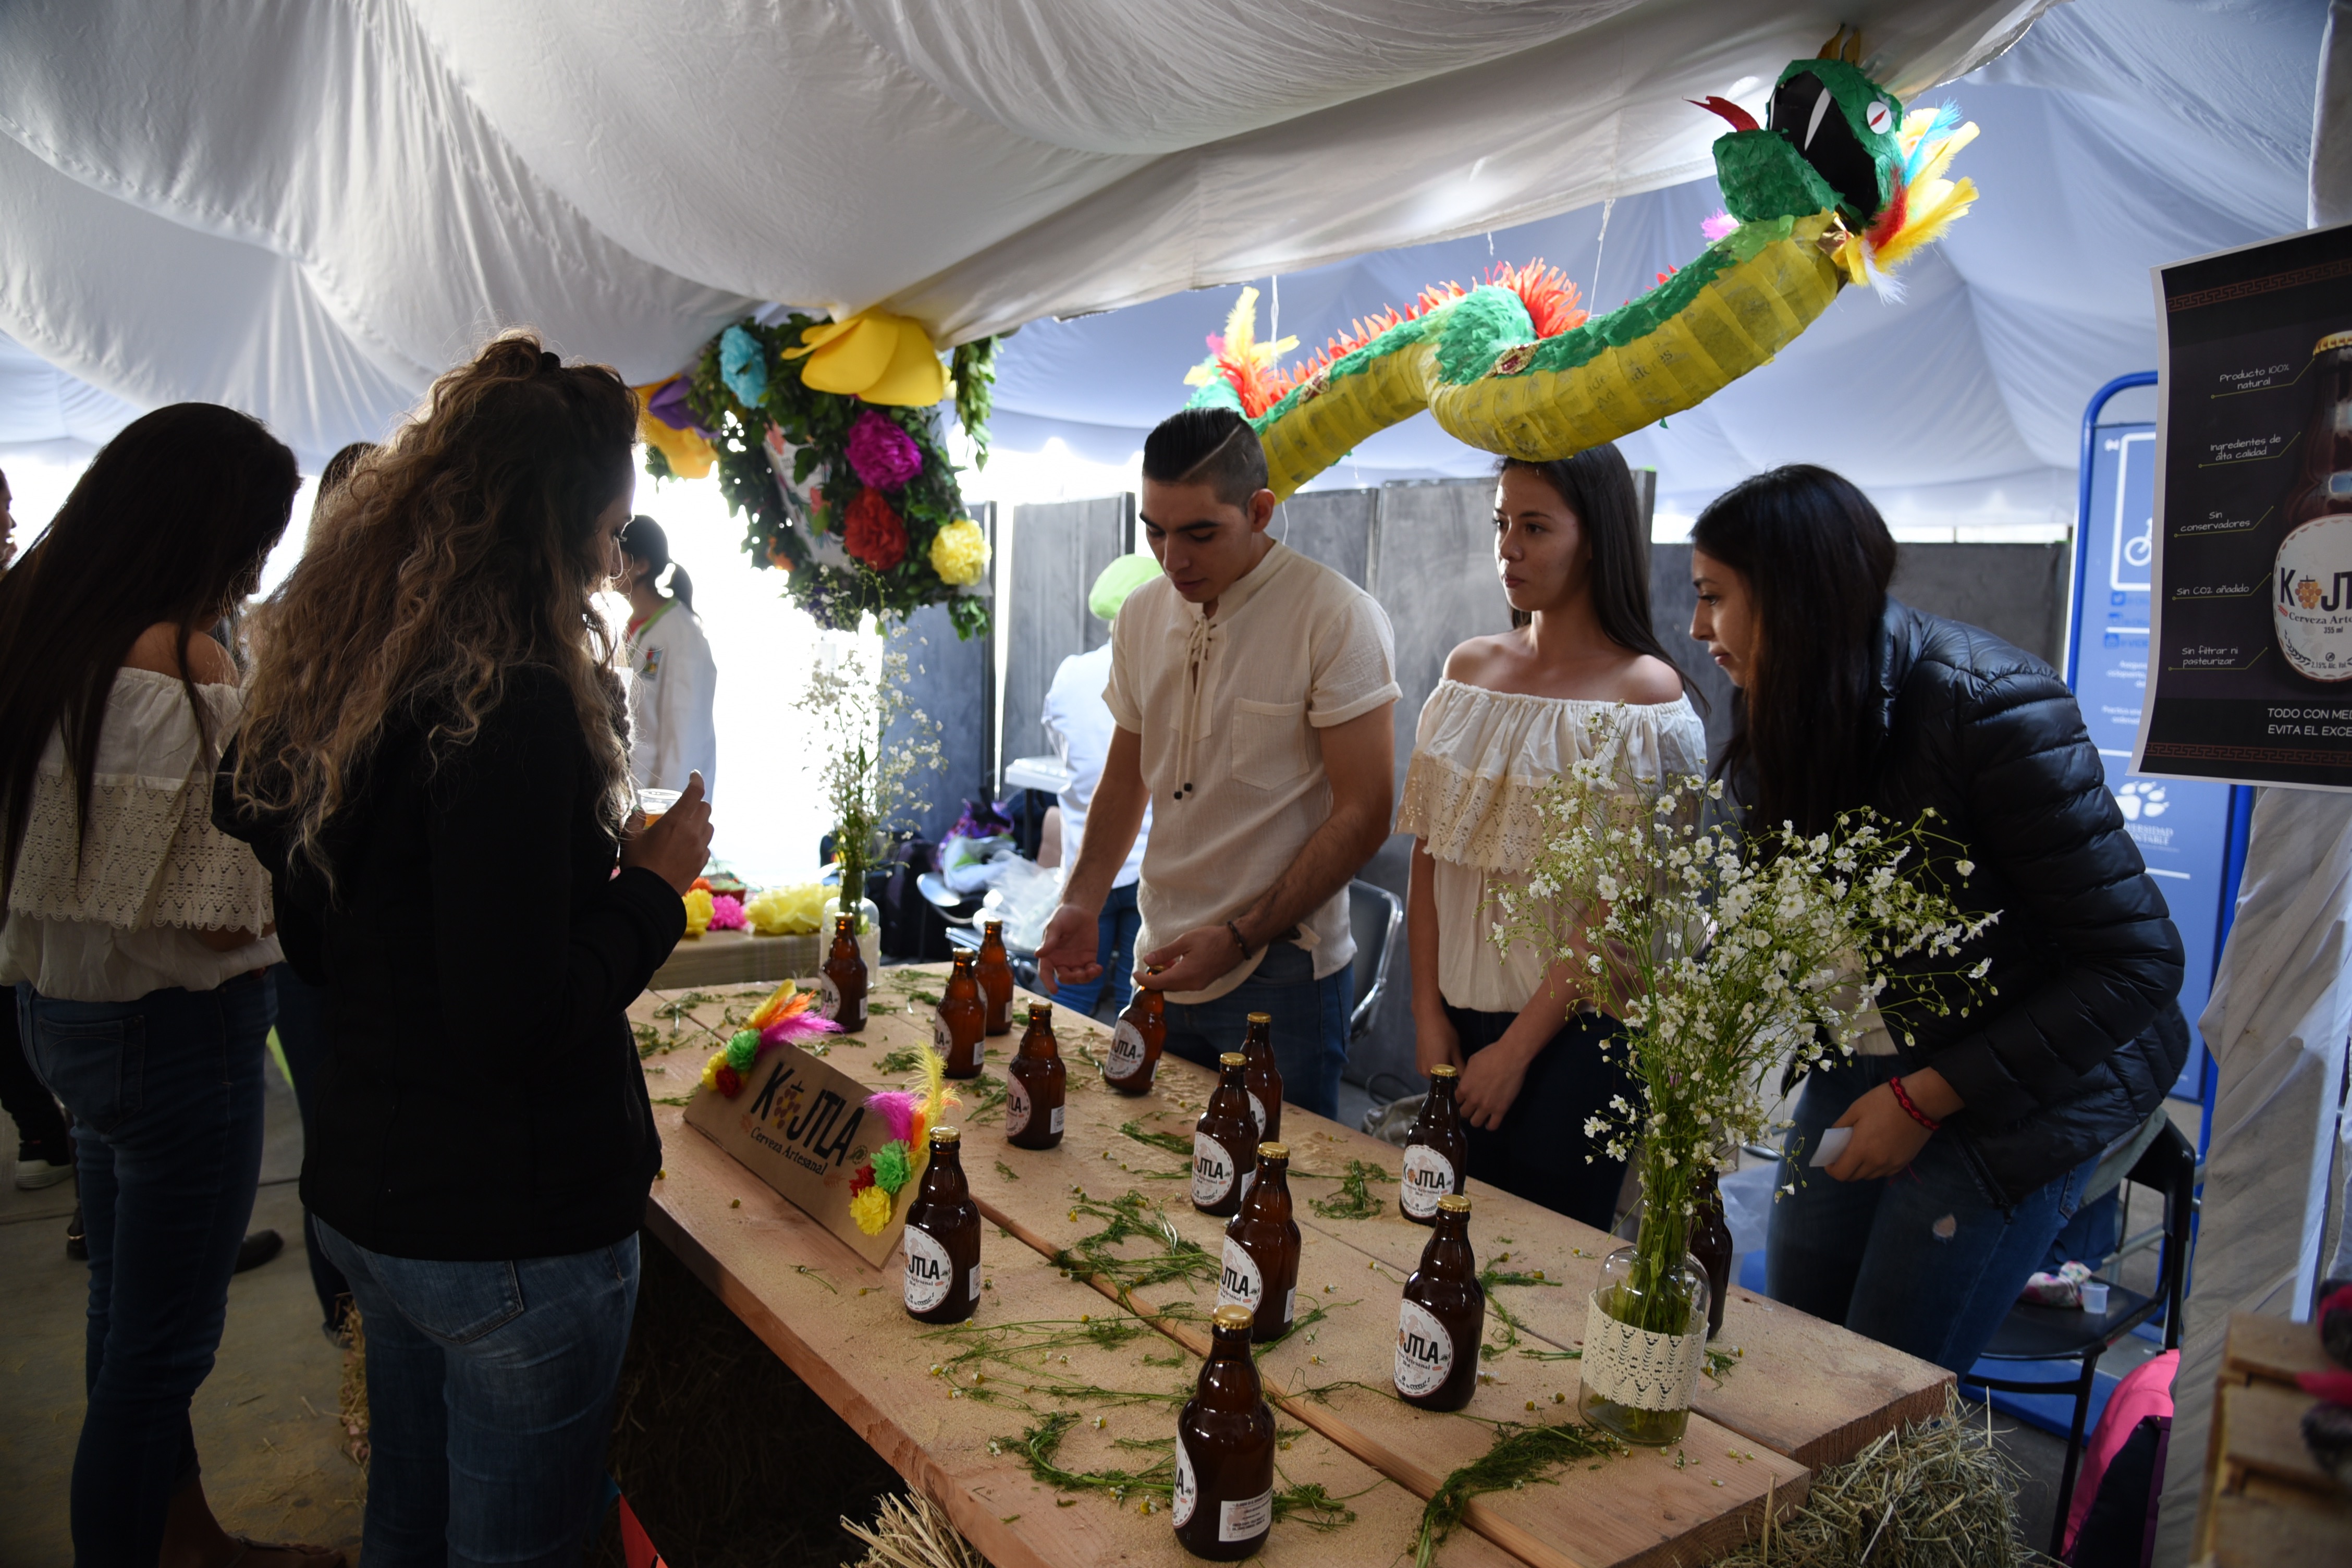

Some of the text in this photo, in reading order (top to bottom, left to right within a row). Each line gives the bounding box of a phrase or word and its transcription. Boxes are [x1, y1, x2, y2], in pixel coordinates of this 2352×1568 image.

[2220, 363, 2289, 382] Producto 100%
[2237, 377, 2271, 389] natural
[2210, 434, 2281, 455] Ingredientes de
[2215, 446, 2267, 461] alta calidad
[2209, 511, 2222, 519] Sin
[2180, 519, 2250, 532] conservadores
[2193, 586, 2213, 595] CO2
[2216, 583, 2249, 594] añadido
[2289, 612, 2326, 624] Cerveza
[2198, 645, 2227, 655] filtrar
[2183, 657, 2235, 668] pasteurizar
[2268, 708, 2300, 718] TODO
[2303, 709, 2329, 719] CON
[2268, 724, 2352, 737] EVITA EL EXCE
[751, 1126, 828, 1176] Cerveza Artesanal
